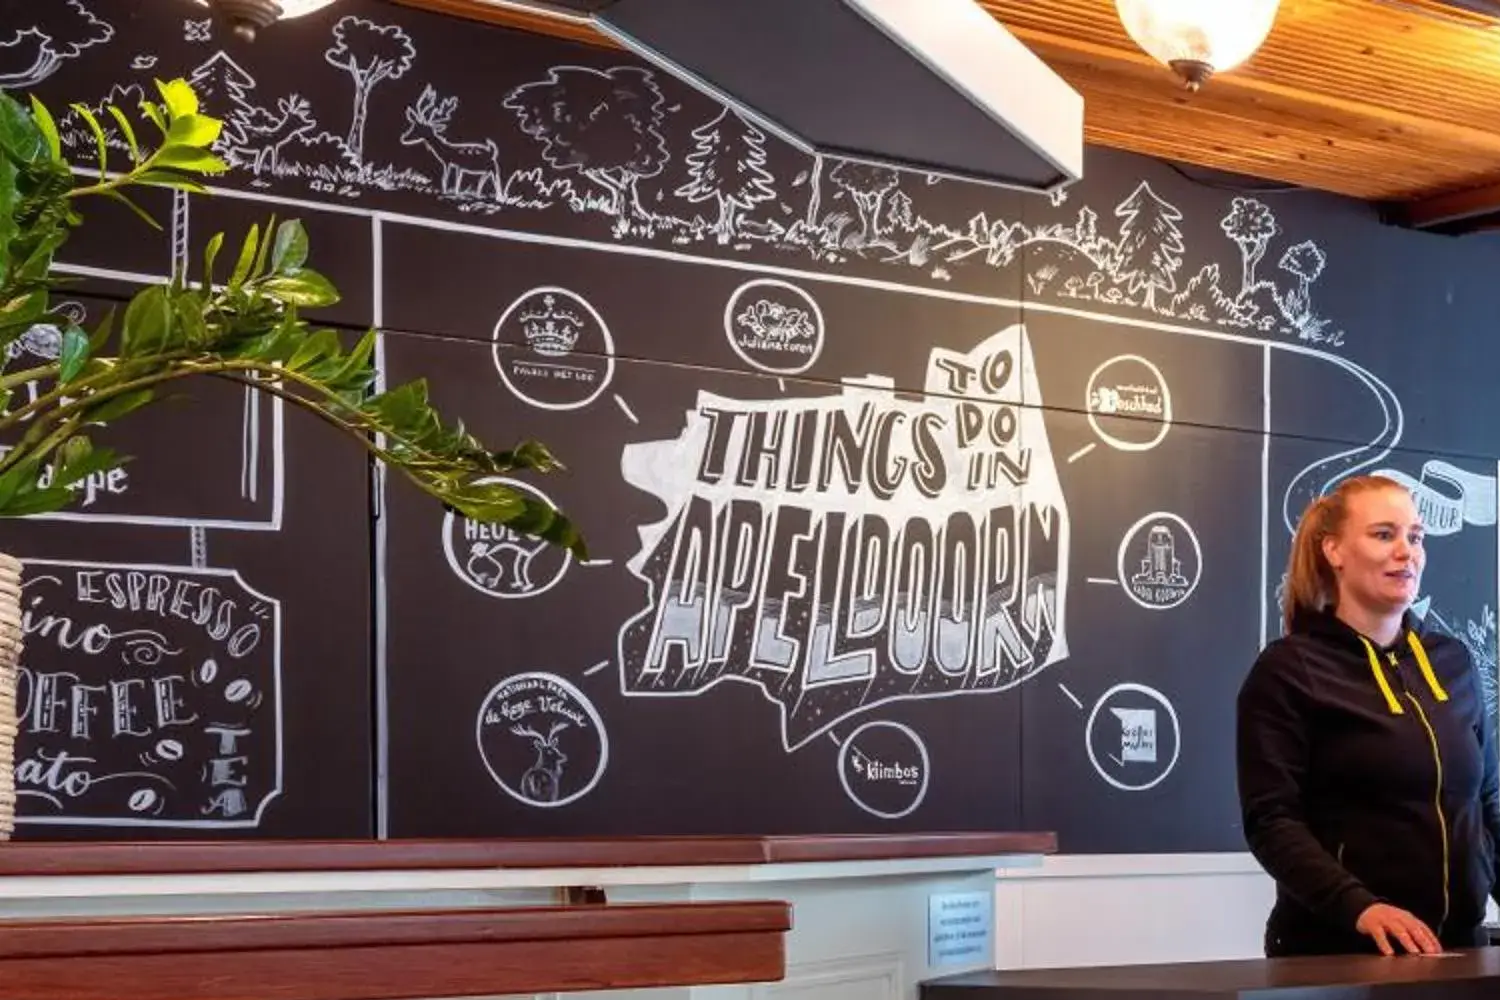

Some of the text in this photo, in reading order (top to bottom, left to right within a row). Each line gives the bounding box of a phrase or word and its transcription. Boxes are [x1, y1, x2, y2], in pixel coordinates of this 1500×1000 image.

[936, 349, 1013, 394] TO
[696, 400, 947, 499] THINGS
[956, 402, 1016, 448] DO
[967, 447, 1032, 491] IN
[77, 571, 260, 658] ESPRESSO
[643, 495, 1067, 690] APELDOORN
[17, 666, 200, 740] OFFEE
[202, 724, 252, 817] TEA
